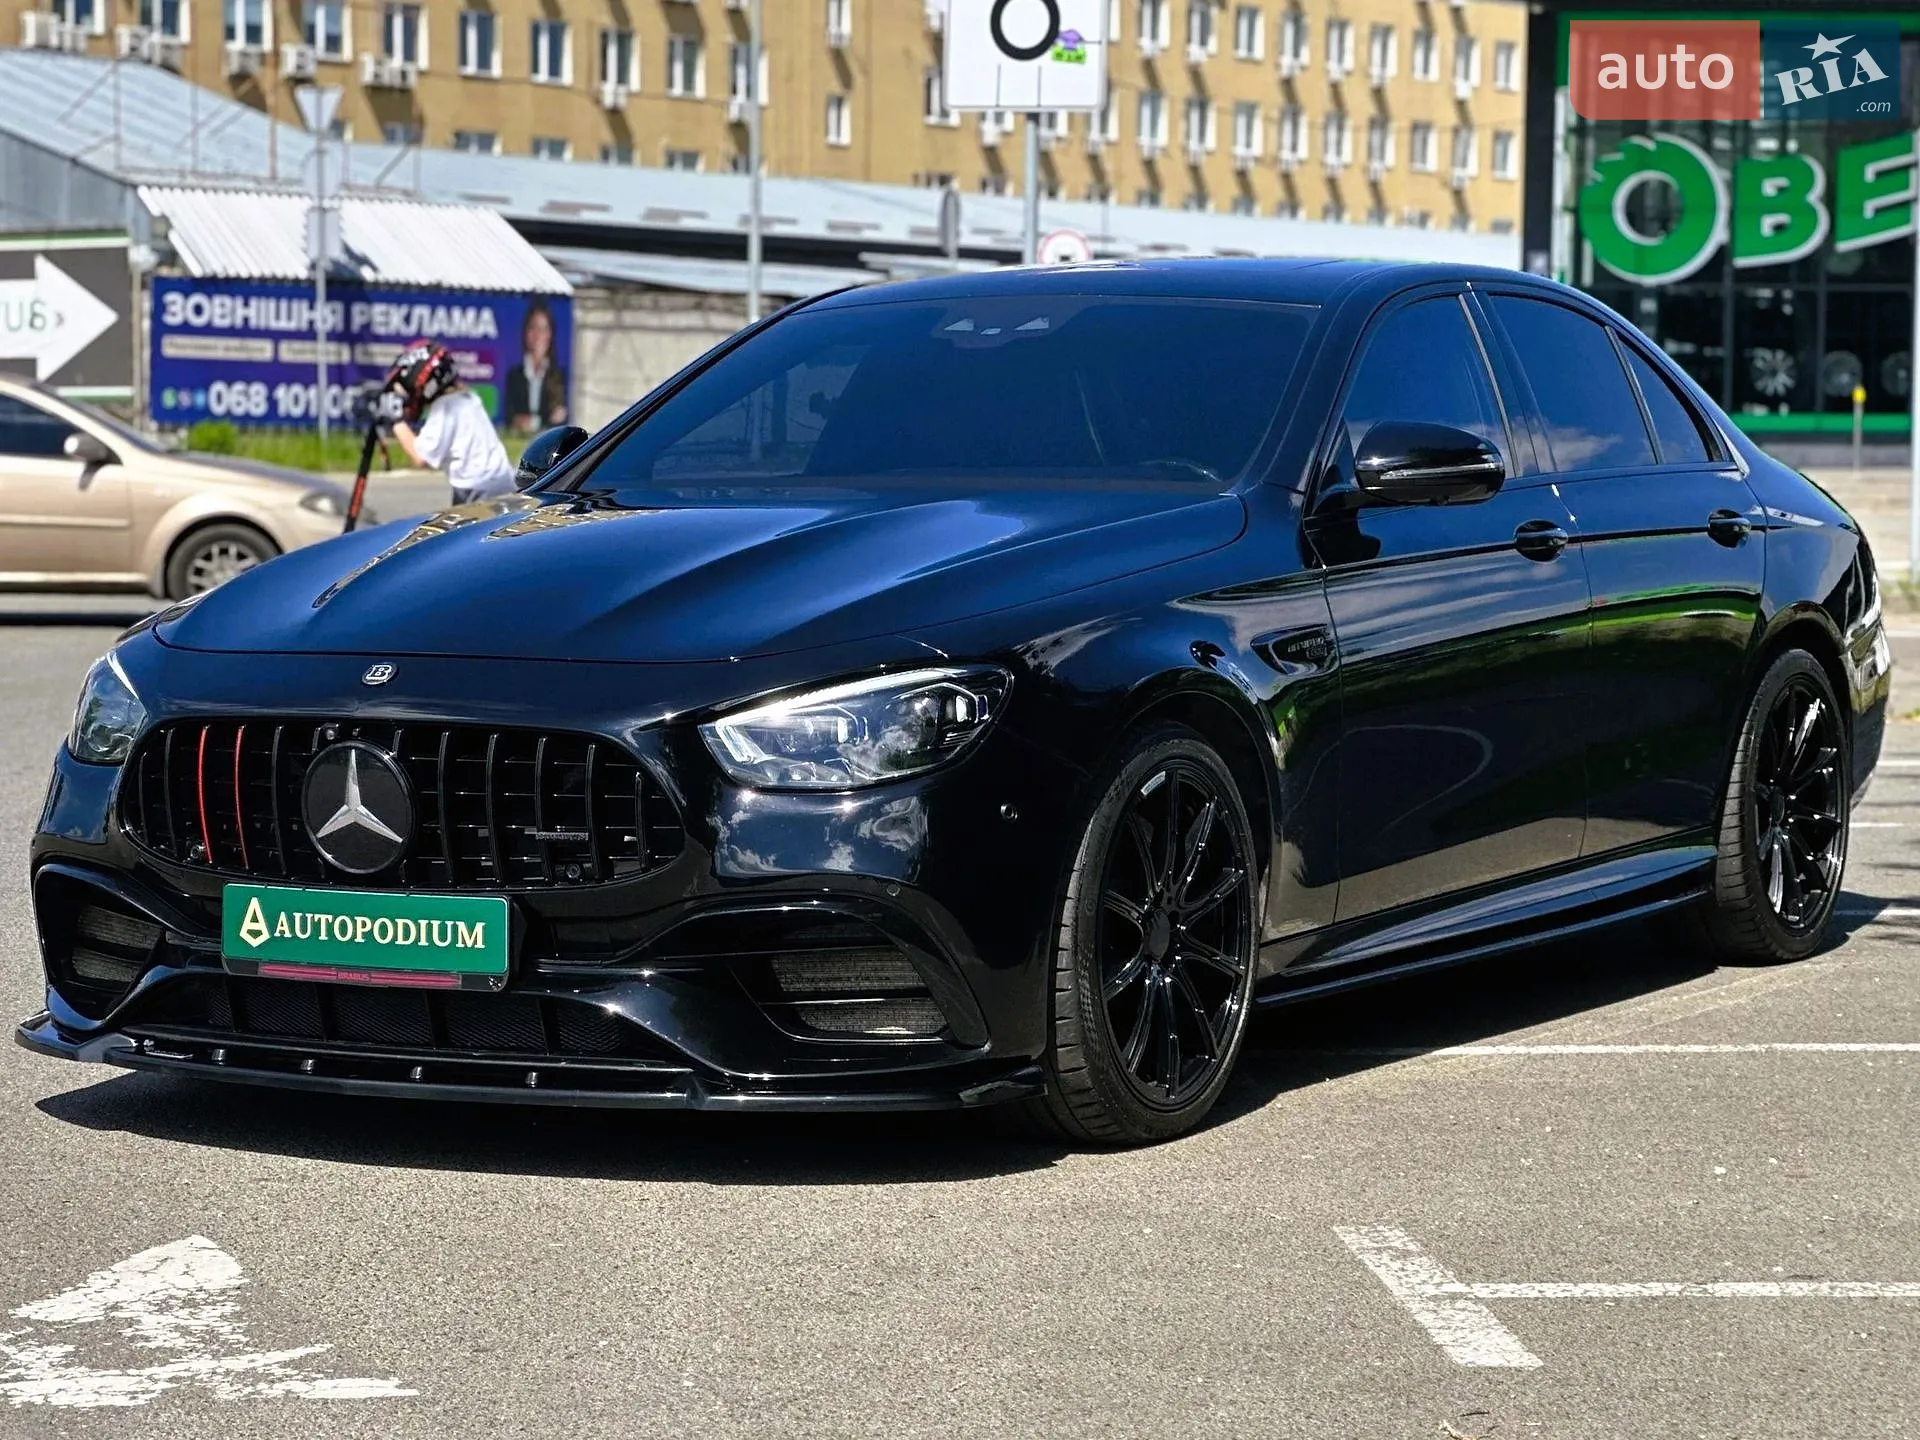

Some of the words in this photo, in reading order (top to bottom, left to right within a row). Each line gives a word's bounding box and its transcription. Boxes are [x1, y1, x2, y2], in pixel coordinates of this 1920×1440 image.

[351, 302, 498, 338] РЕКЛАМА
[208, 379, 269, 417] 068
[274, 911, 486, 949] AUTOPODIUM
